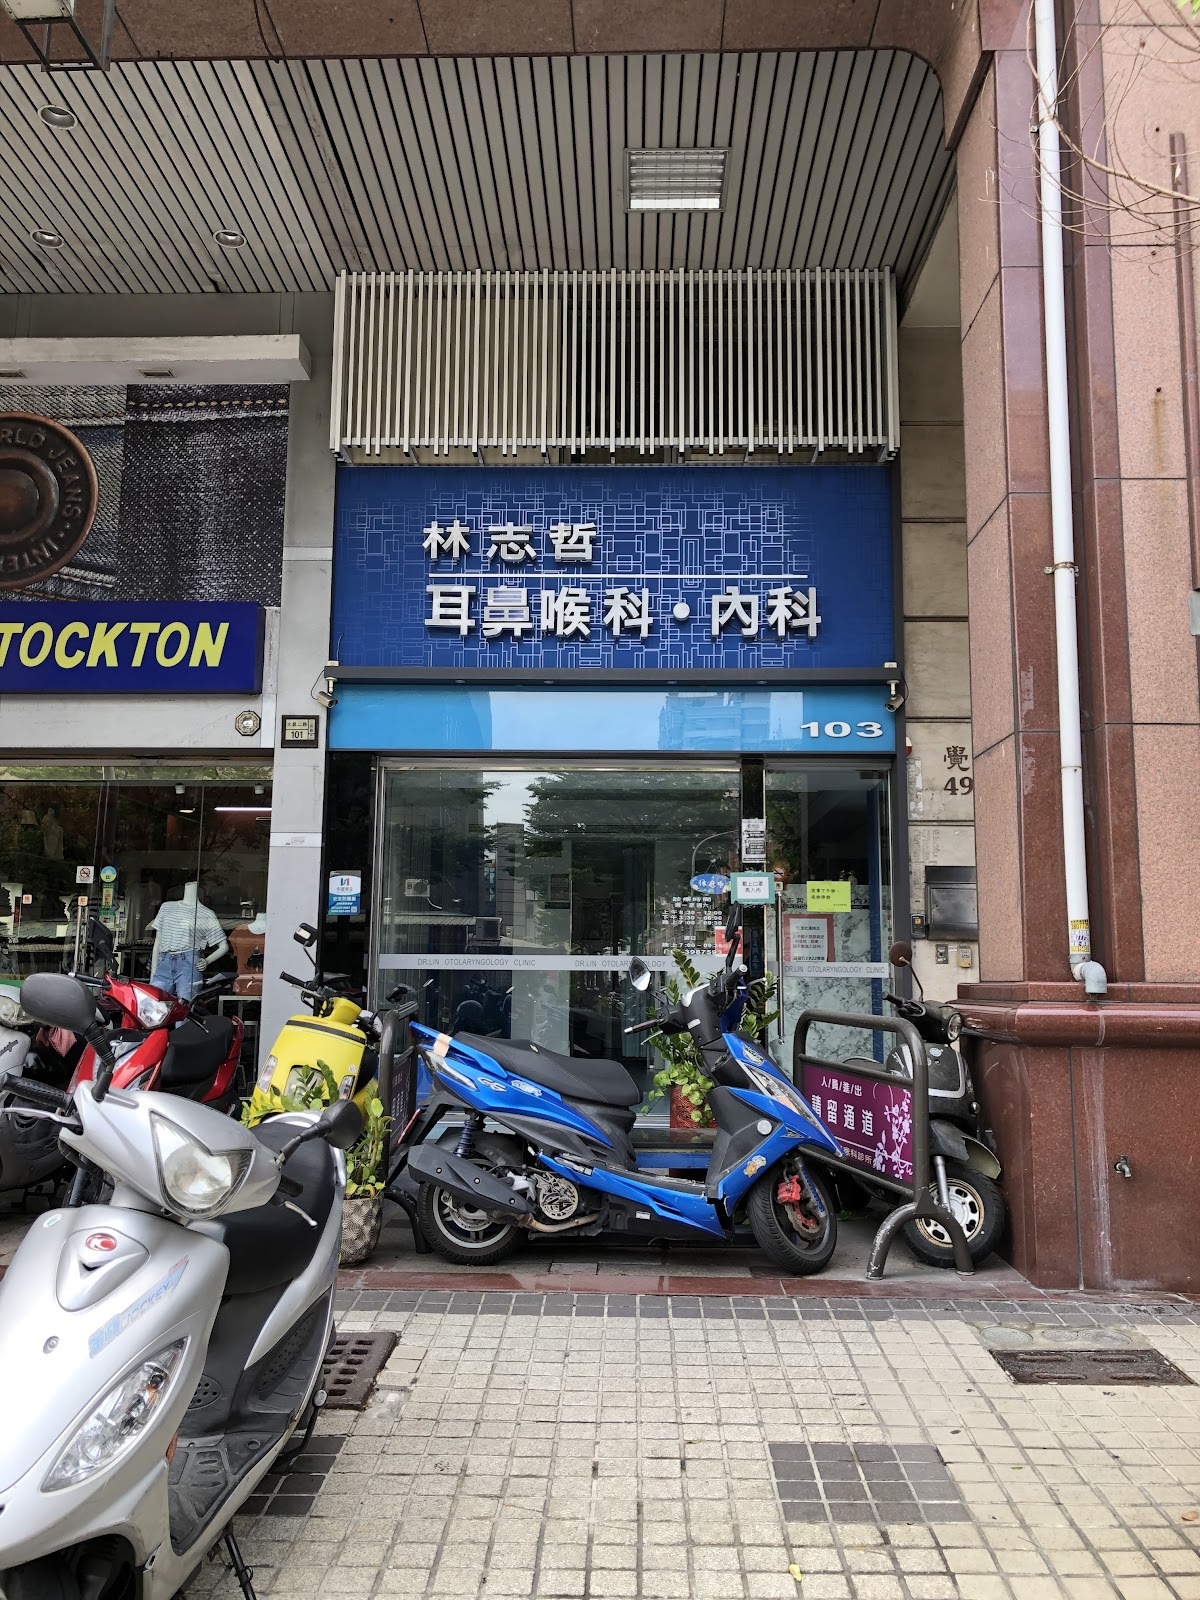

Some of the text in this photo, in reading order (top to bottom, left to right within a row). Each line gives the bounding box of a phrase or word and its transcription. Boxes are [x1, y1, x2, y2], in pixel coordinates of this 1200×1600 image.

[50, 447, 82, 520] JEANS
[422, 519, 598, 563] 林志哲
[0, 537, 59, 574] INTE
[0, 621, 230, 668] TOCKTON
[291, 730, 303, 739] 101
[800, 720, 884, 739] 103
[943, 745, 971, 772] 覺
[943, 776, 974, 796] 49
[417, 958, 536, 967] DR.LIN OTOLARYNGOLOGY CLINIC
[784, 965, 885, 974] DR.LIN OTOLARYNGOLOGY CLINIC
